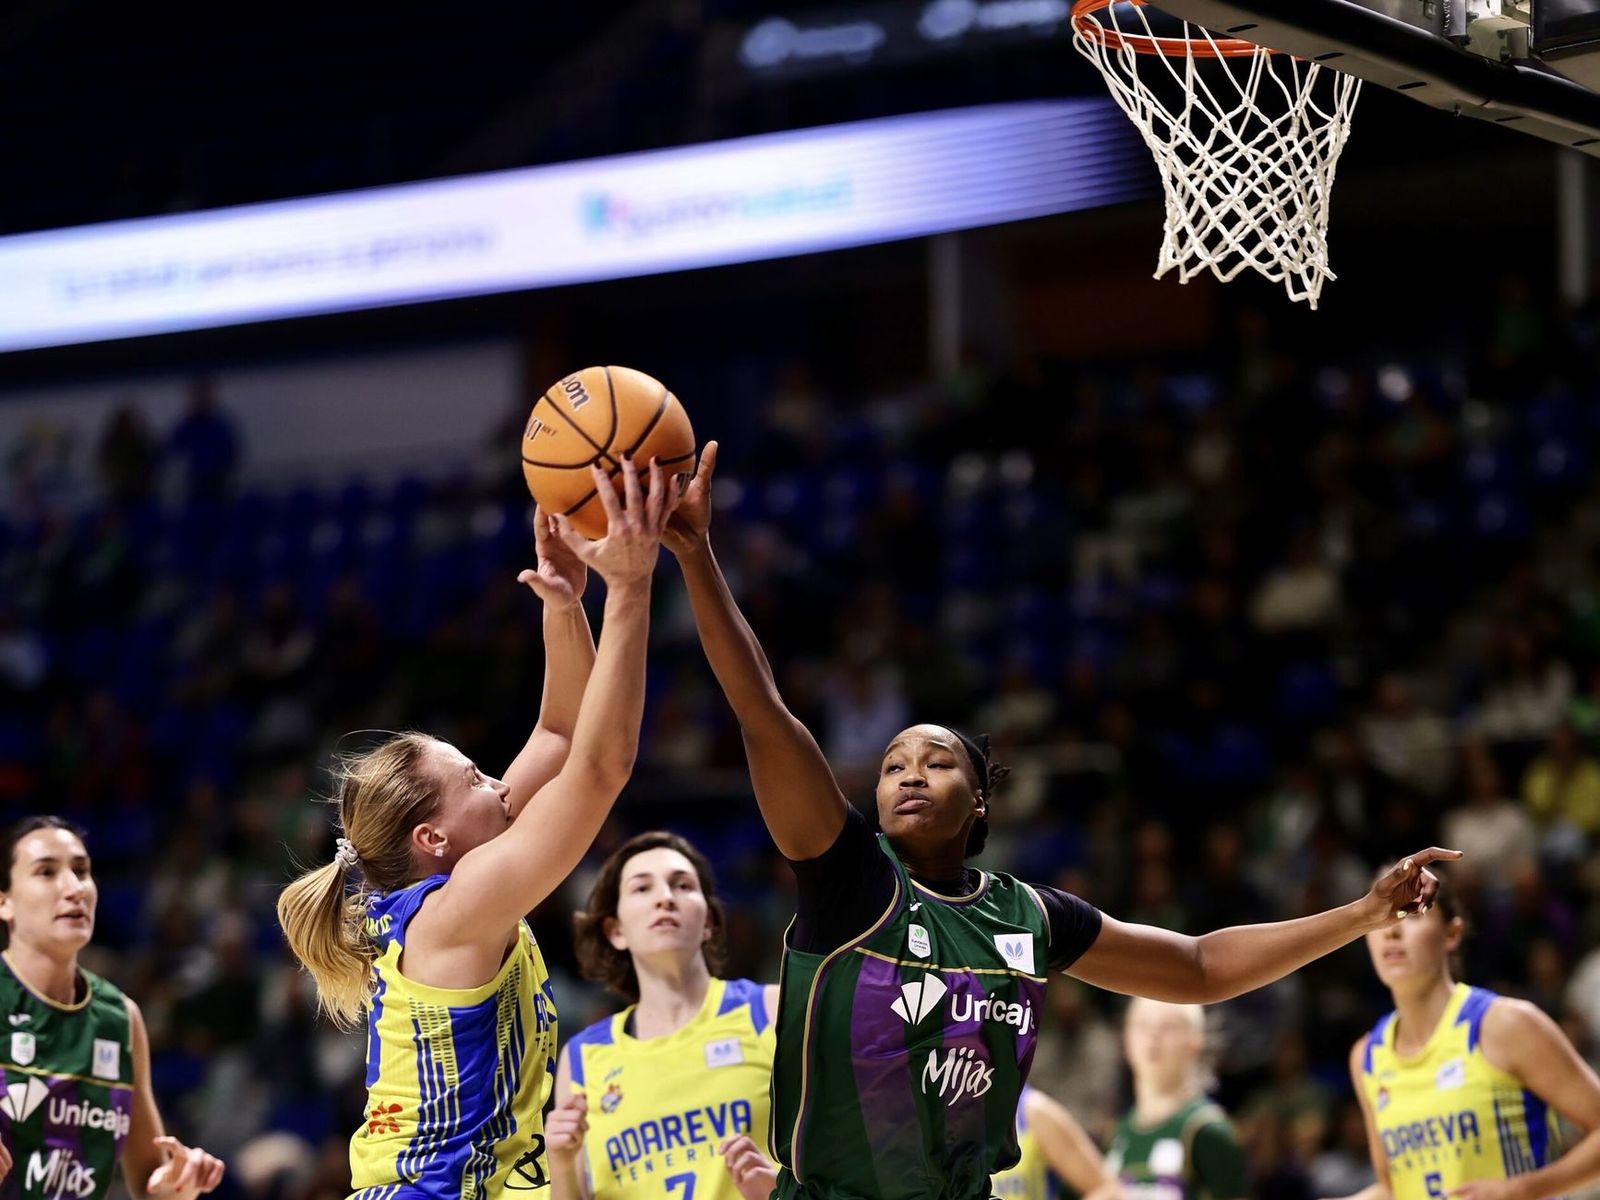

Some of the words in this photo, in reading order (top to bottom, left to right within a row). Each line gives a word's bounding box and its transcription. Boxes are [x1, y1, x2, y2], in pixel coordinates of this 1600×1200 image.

[922, 1047, 995, 1106] Mijas
[49, 1097, 130, 1140] Unicaja
[605, 1099, 752, 1172] ADAREVA
[1383, 1109, 1480, 1158] DAREVA
